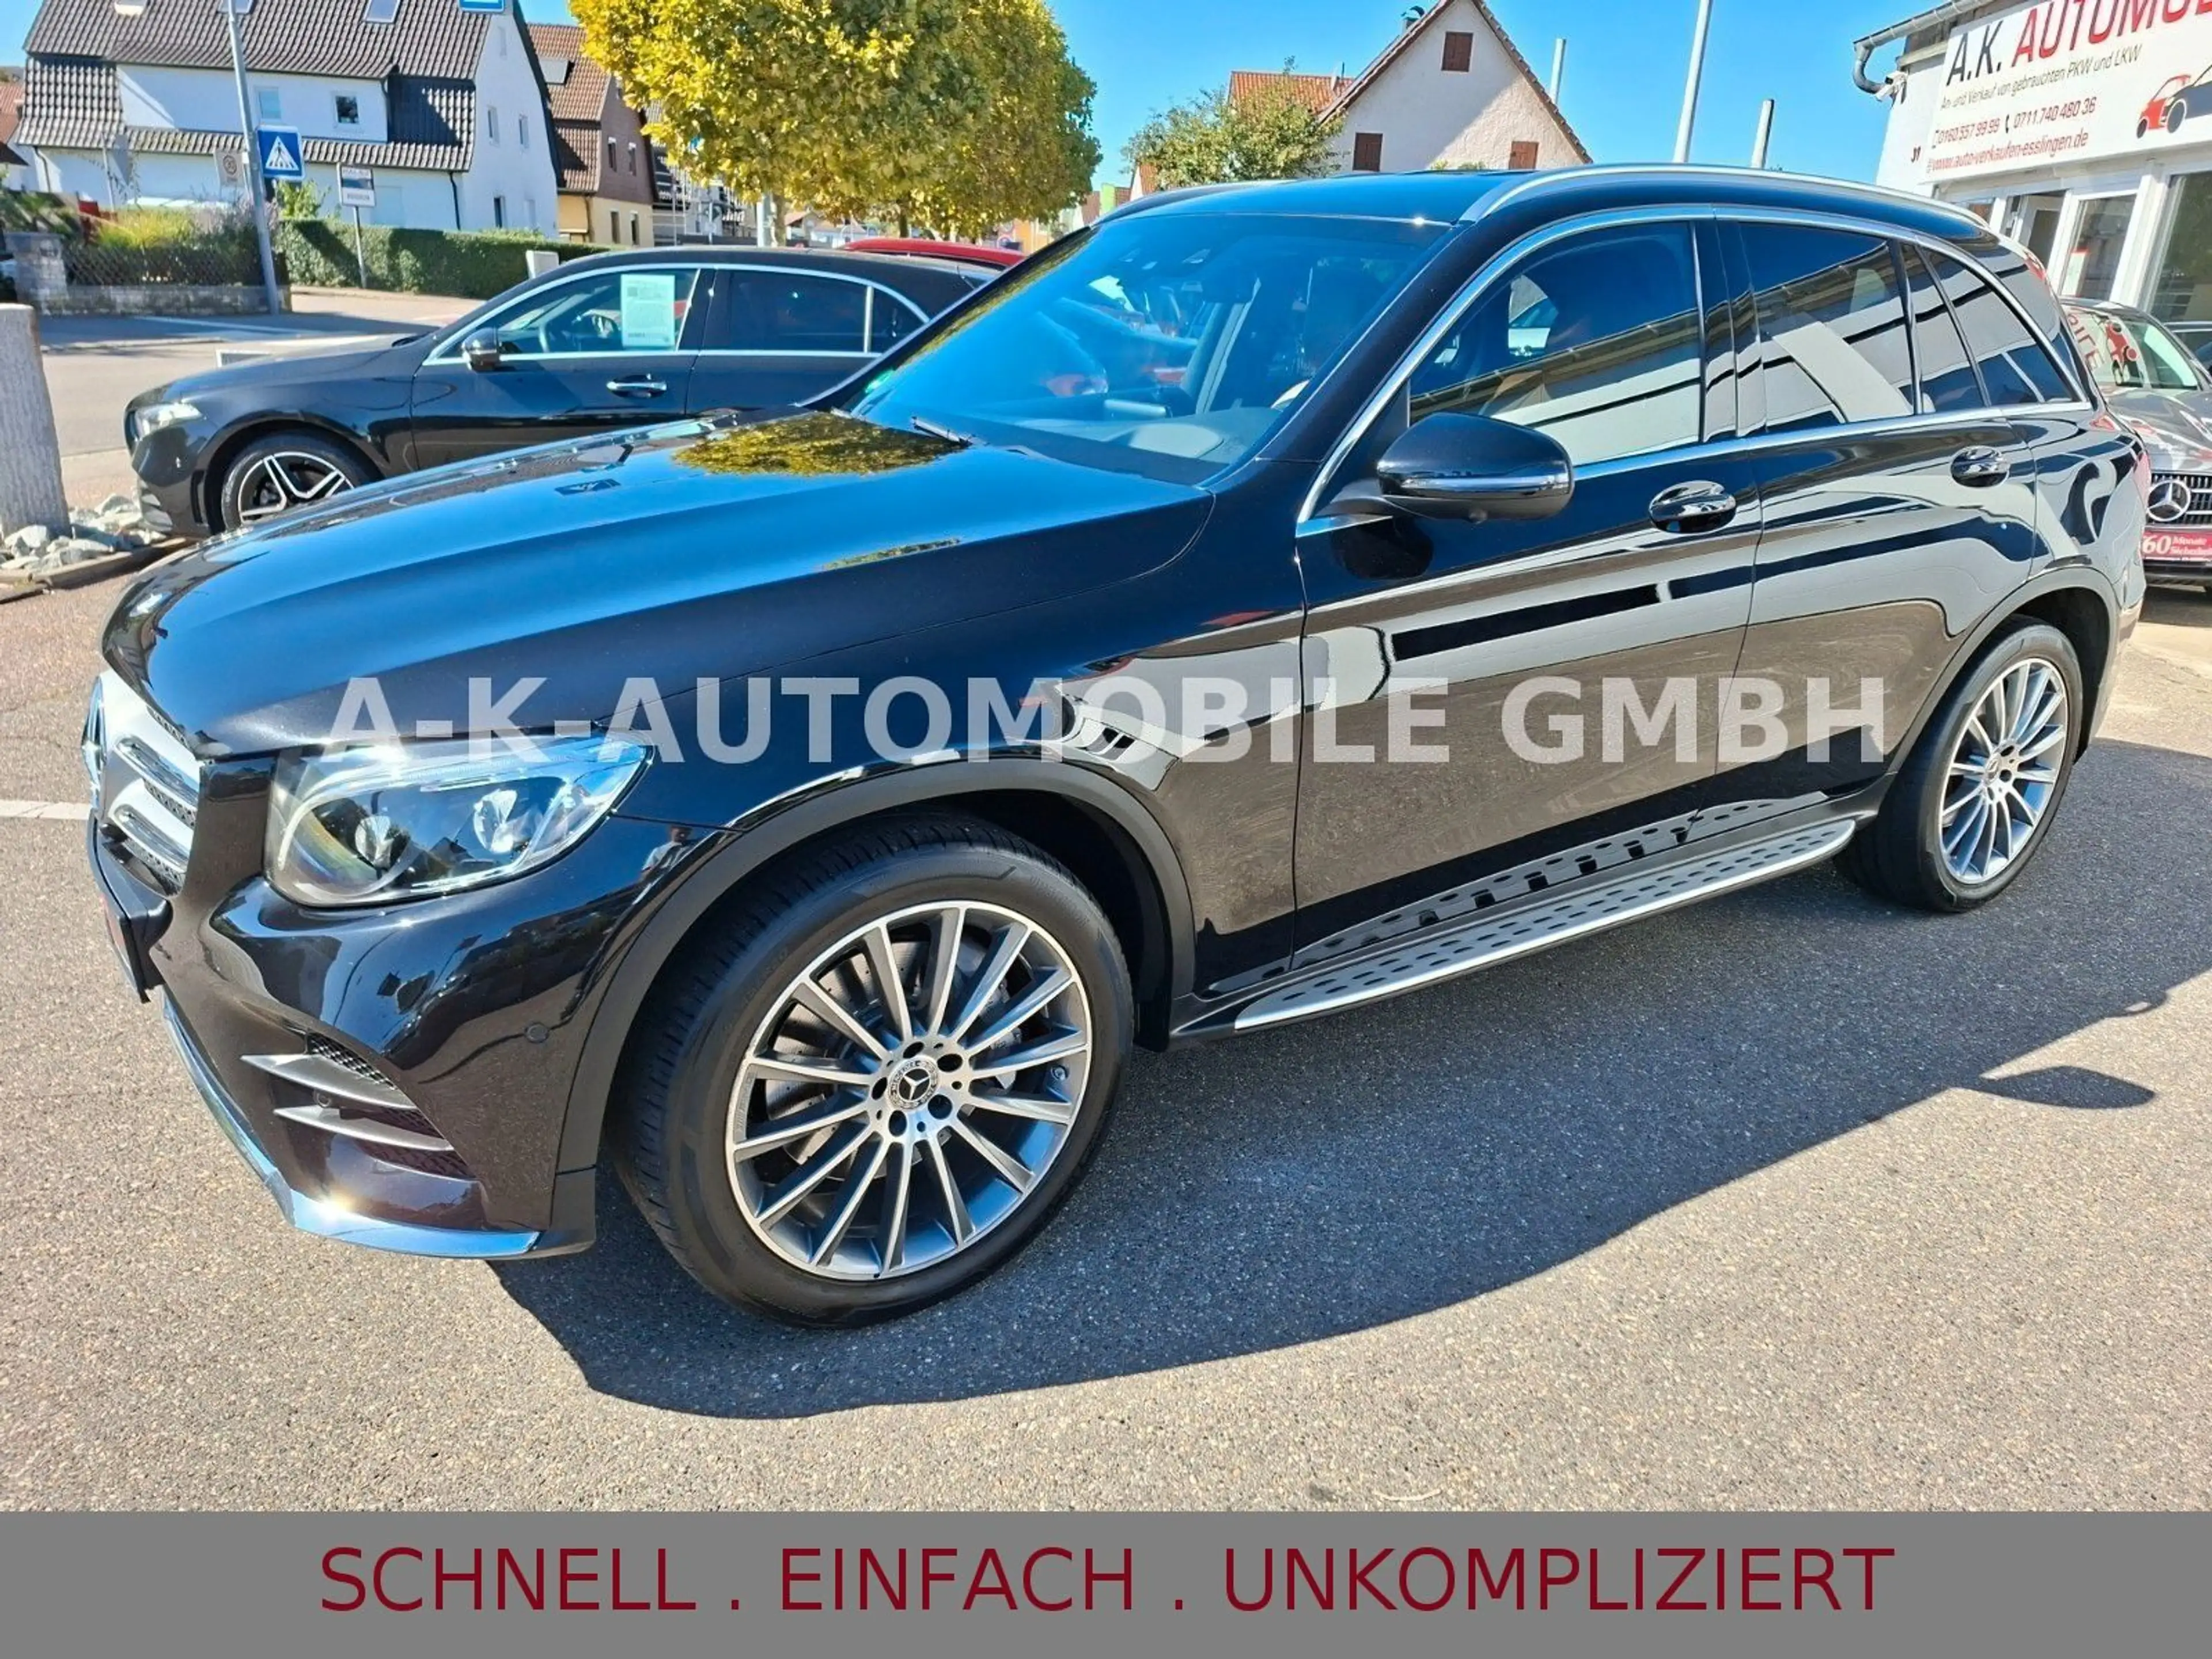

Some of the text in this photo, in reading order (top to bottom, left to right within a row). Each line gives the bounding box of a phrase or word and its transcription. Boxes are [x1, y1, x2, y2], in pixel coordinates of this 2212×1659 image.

[1946, 20, 2002, 86] A.K.
[2066, 56, 2094, 78] PKW
[2093, 51, 2114, 71] und
[2114, 43, 2142, 67] LKW
[2059, 100, 2081, 119] 480
[2081, 96, 2097, 115] 36
[2142, 535, 2172, 555] 60
